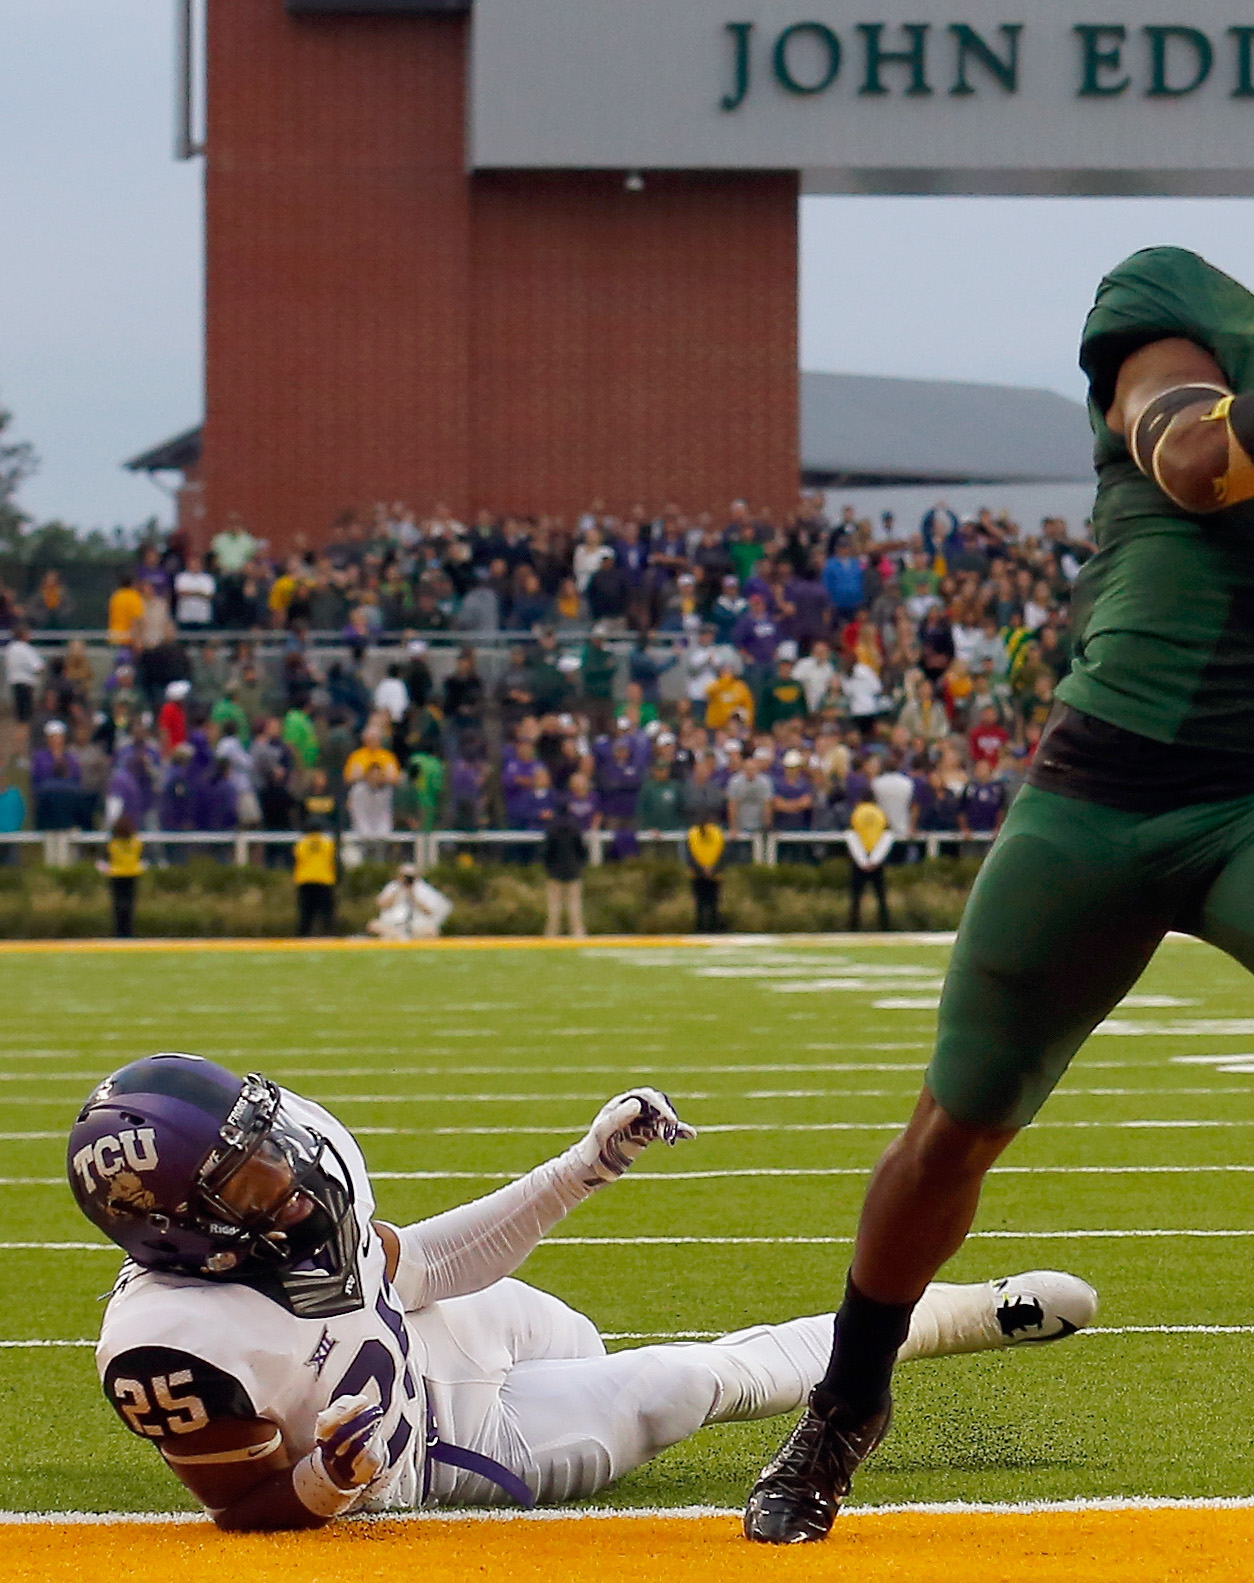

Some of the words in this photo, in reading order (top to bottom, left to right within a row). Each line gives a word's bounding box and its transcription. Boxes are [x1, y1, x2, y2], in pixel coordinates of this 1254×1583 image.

[720, 20, 1023, 113] JOHN
[72, 1127, 160, 1194] TCU
[113, 1368, 210, 1436] 25
